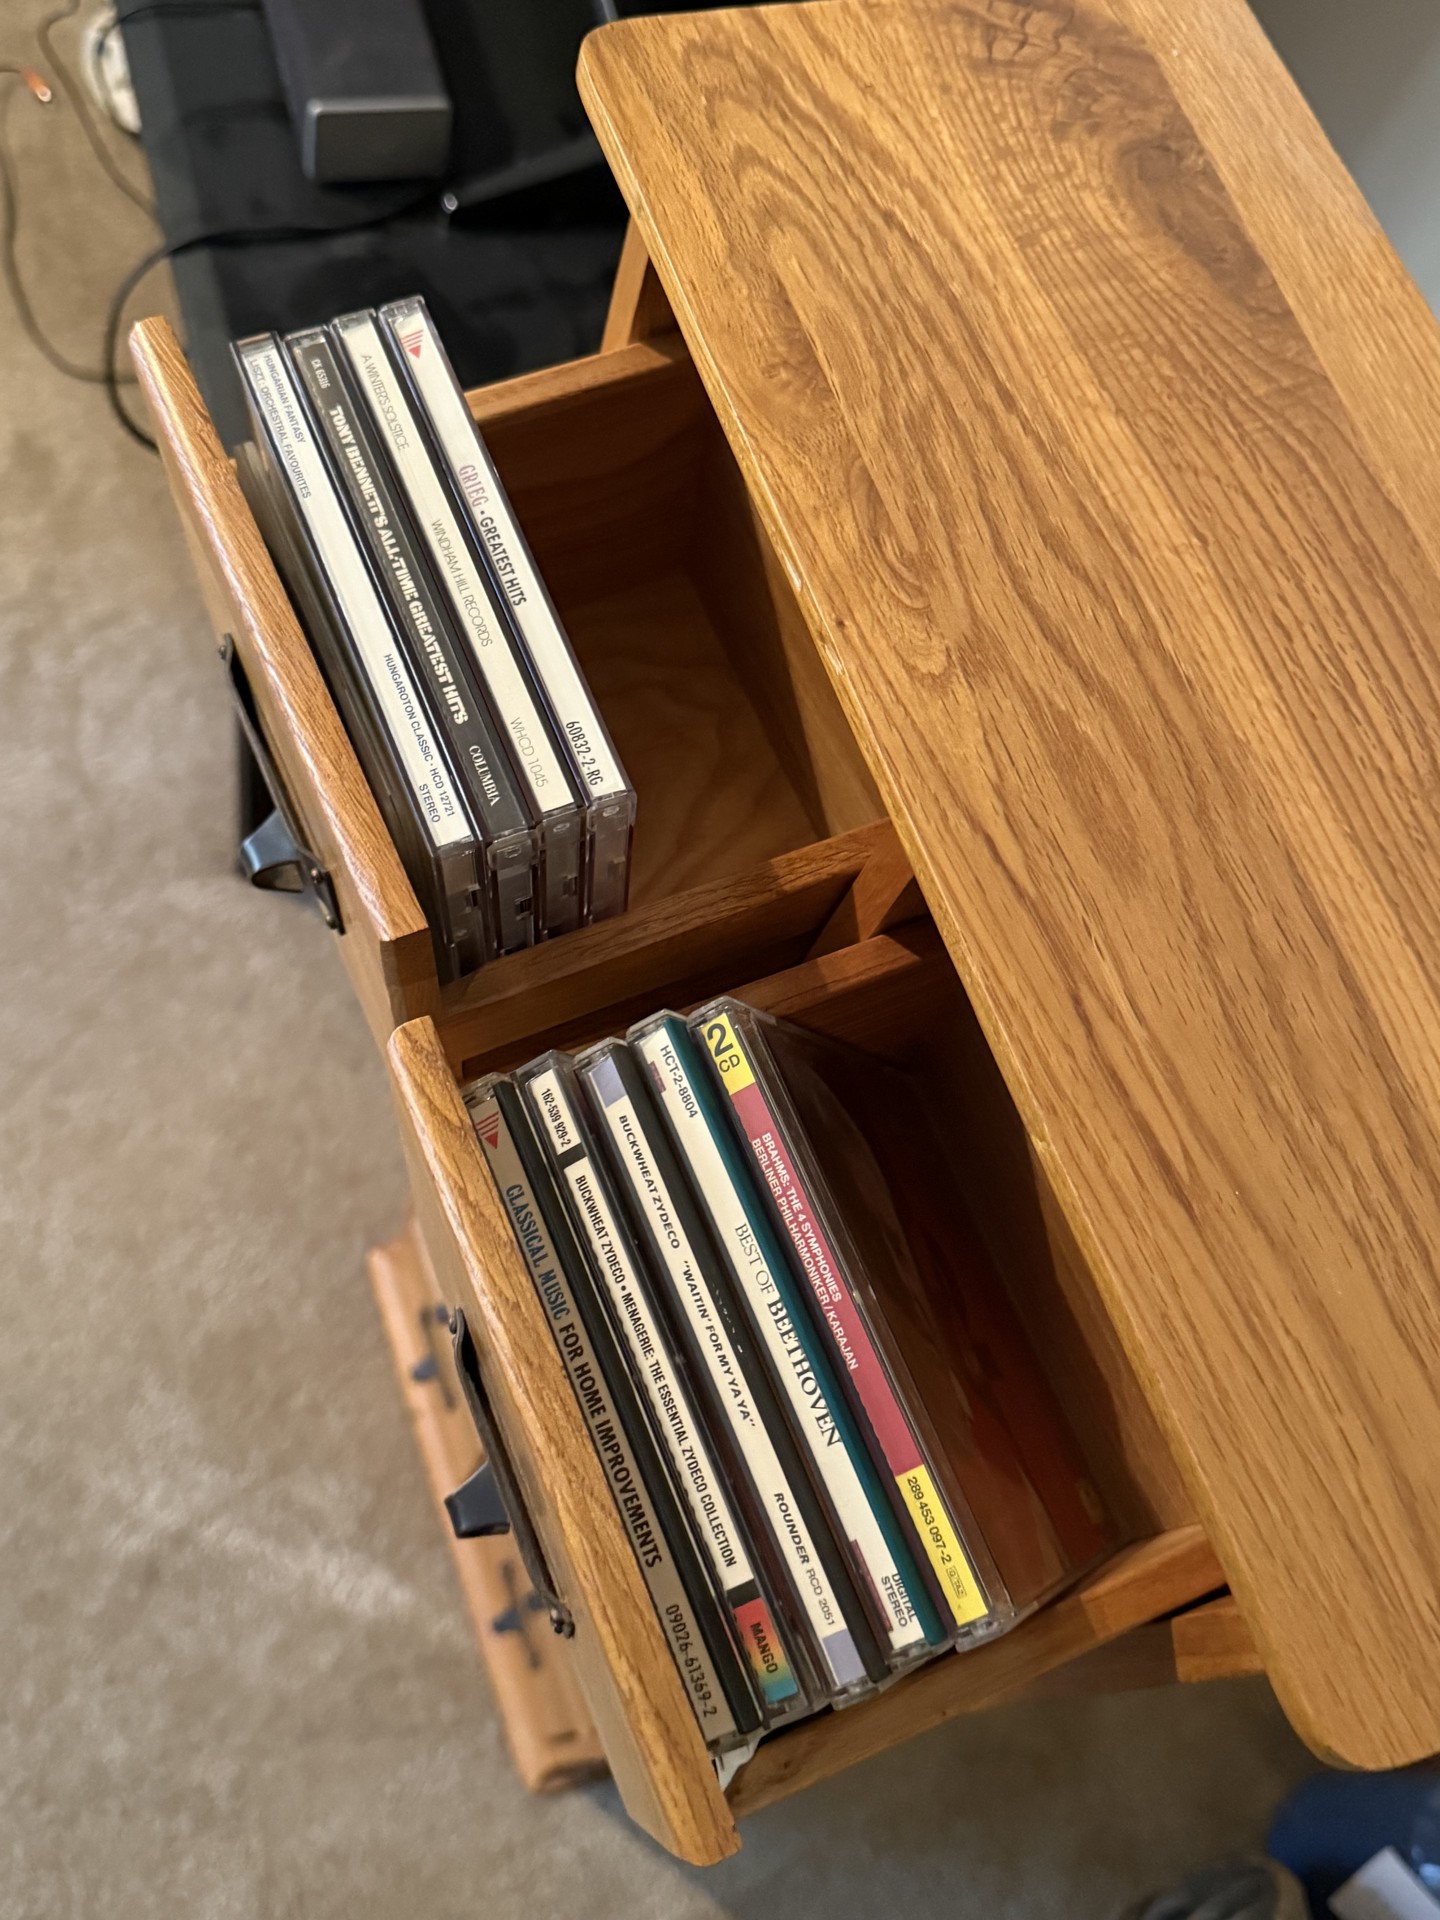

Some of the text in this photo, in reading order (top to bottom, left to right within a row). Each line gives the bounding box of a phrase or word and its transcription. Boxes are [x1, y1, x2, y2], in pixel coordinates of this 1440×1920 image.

[261, 386, 288, 444] ORCHESTRAL
[284, 444, 312, 499] FAVOURITES
[264, 355, 306, 444] HUNGARIAN FANTASY
[361, 355, 372, 364] A
[382, 405, 410, 450] SOLSTICE
[329, 405, 469, 725] TONY BENNETT'S ALL-TIME GREATEST HITS
[431, 519, 494, 647] WINDHAM HILL RECORDS
[459, 464, 528, 607] GRIEG GREATEST HITS
[384, 653, 455, 817] HUNGAROTON CLASSIC HCD 12721
[469, 745, 501, 807] COLUMBIA
[510, 716, 549, 788] WHCD 1045
[565, 721, 604, 786] 60832-2-RG
[419, 783, 441, 823] STEREO
[660, 1044, 698, 1118] HCT-2-8804
[707, 1023, 734, 1058] 2
[719, 1054, 741, 1073] CD
[541, 1088, 572, 1148] 162-539 929-2
[619, 1115, 658, 1194] BUCKWHEAT
[652, 1194, 681, 1249] ZYDECO
[705, 1325, 723, 1353] FOR
[717, 1352, 733, 1376] MY
[728, 1377, 744, 1399] YA
[752, 1138, 783, 1200] BERLINER
[826, 1310, 859, 1370] KARAJAN
[761, 1132, 842, 1302] BRAHMS: THE 4 SYMPHONIES
[506, 1184, 663, 1568] CLASSICAL MUSIC FOR HOME IMPROVEMENTS
[575, 1175, 737, 1568] BUCKWHEAT ZYDECO MENAGERIE: THE ESSENTIAL ZYDECO COLLECTION
[734, 1223, 843, 1448] BEST OF BEETHOVEN
[774, 1492, 835, 1626] ROUNDER RCD 2051
[907, 1476, 952, 1566] 289 453 097-2
[881, 1575, 908, 1628] STEREO
[891, 1572, 917, 1623] DIGITAL
[665, 1604, 718, 1718] 09026-61369-2
[750, 1621, 779, 1674] MANGO
